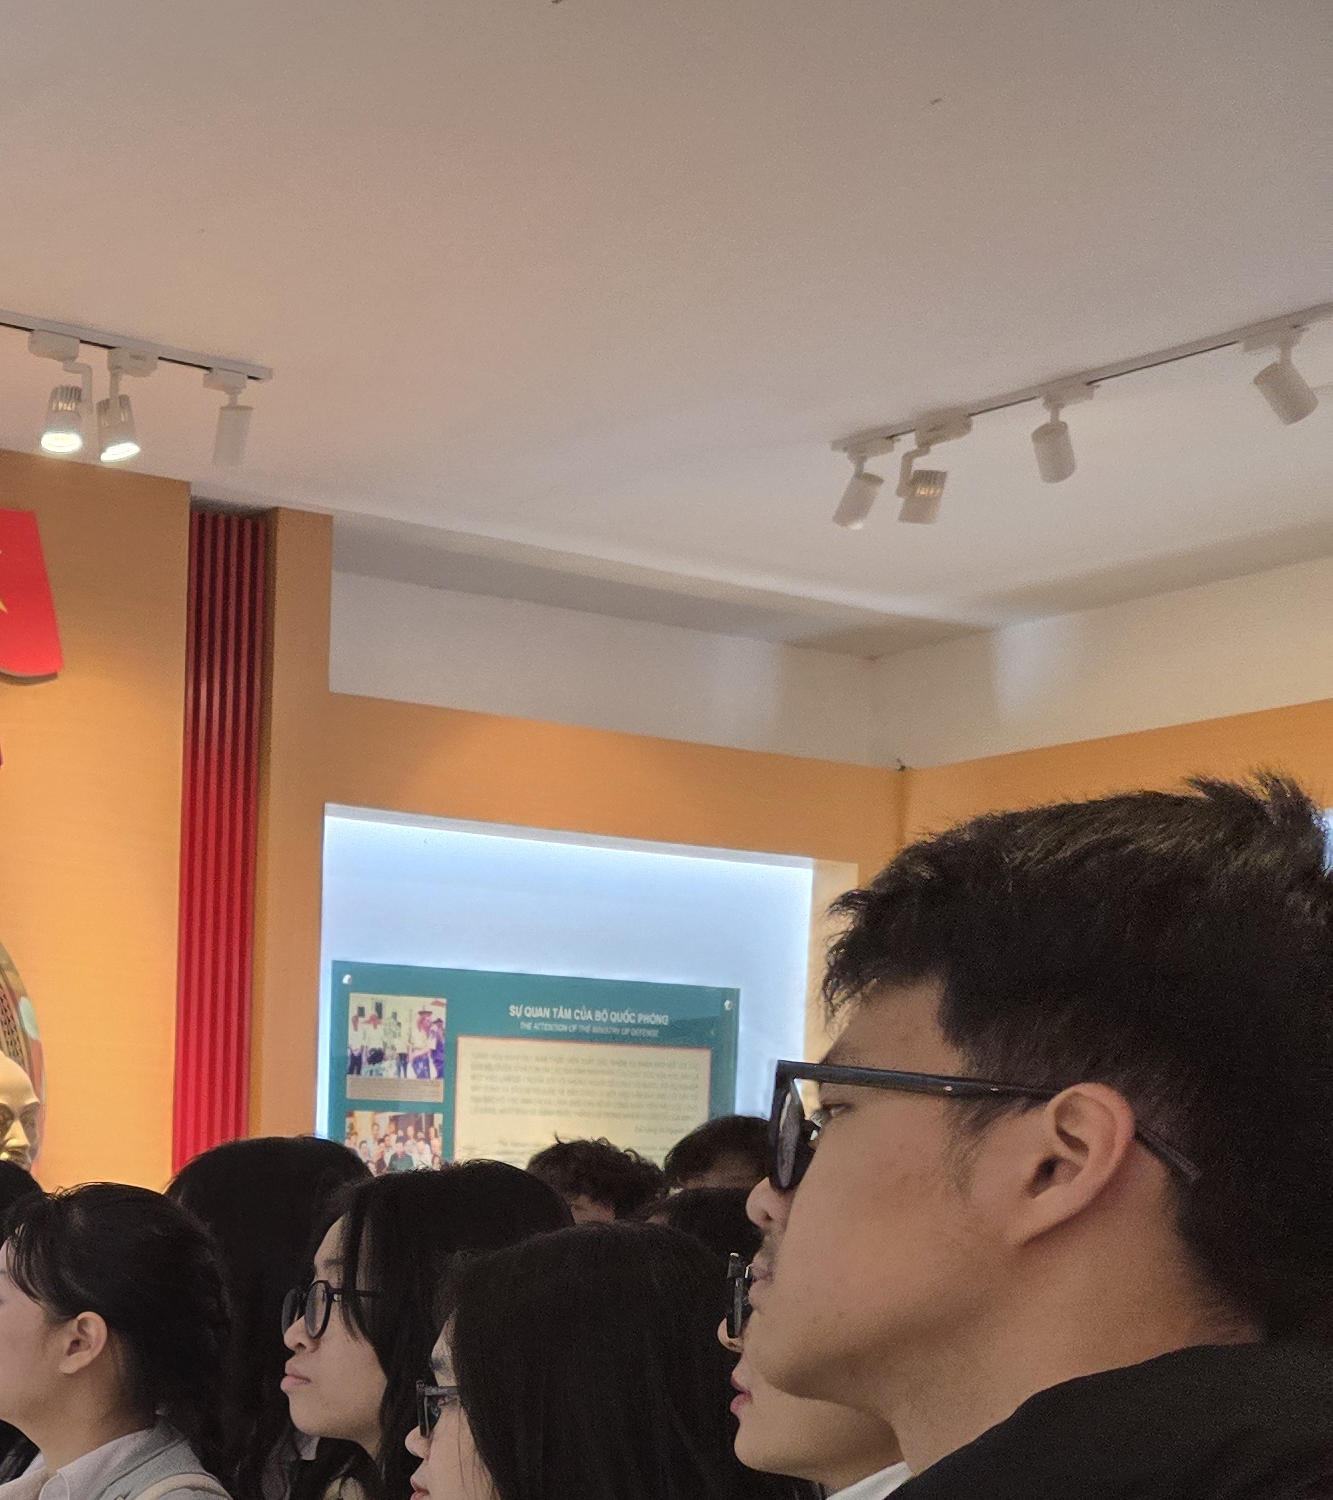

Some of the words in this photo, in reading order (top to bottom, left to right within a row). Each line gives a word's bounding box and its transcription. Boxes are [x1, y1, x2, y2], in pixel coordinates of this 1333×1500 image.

[509, 1004, 523, 1019] SỰ
[524, 1006, 550, 1018] QUAN
[552, 1005, 572, 1020] TÂM
[574, 1006, 593, 1021] CỦA
[610, 1008, 636, 1024] QUỐC
